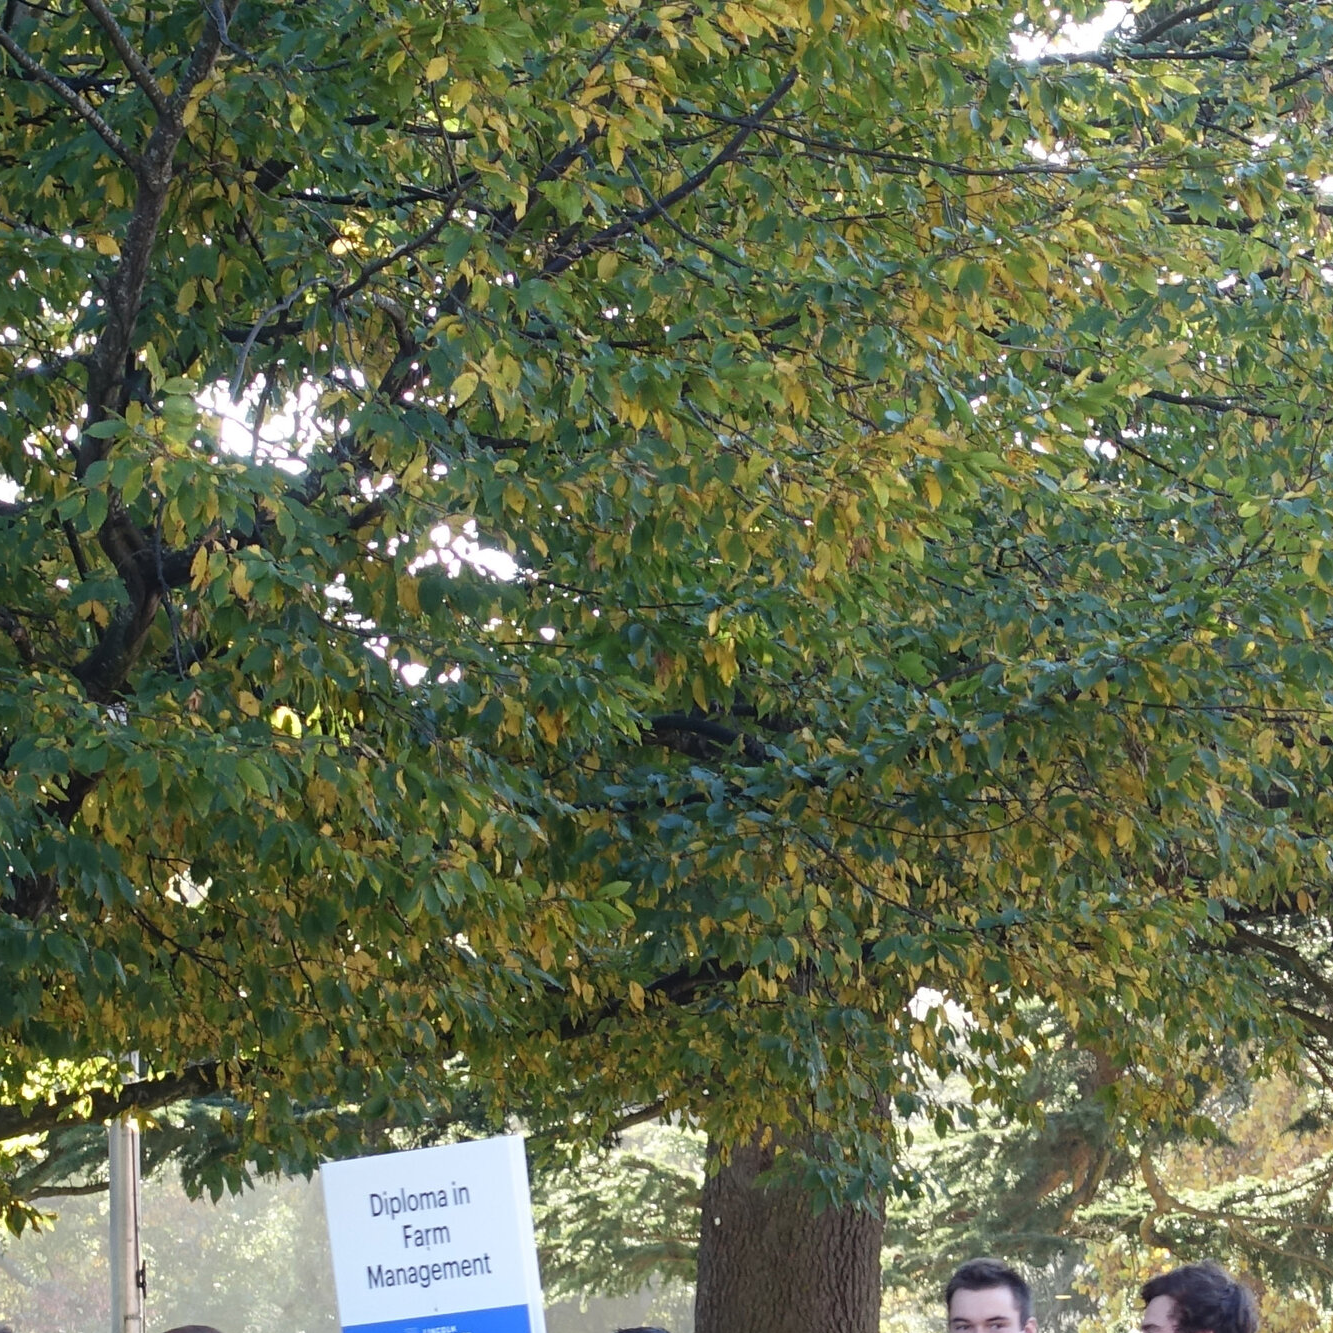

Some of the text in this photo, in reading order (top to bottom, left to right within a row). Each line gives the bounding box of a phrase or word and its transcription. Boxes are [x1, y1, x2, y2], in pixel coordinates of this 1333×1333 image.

[369, 1181, 471, 1220] Diploma in
[402, 1224, 451, 1249] Farm
[366, 1252, 492, 1289] Management
